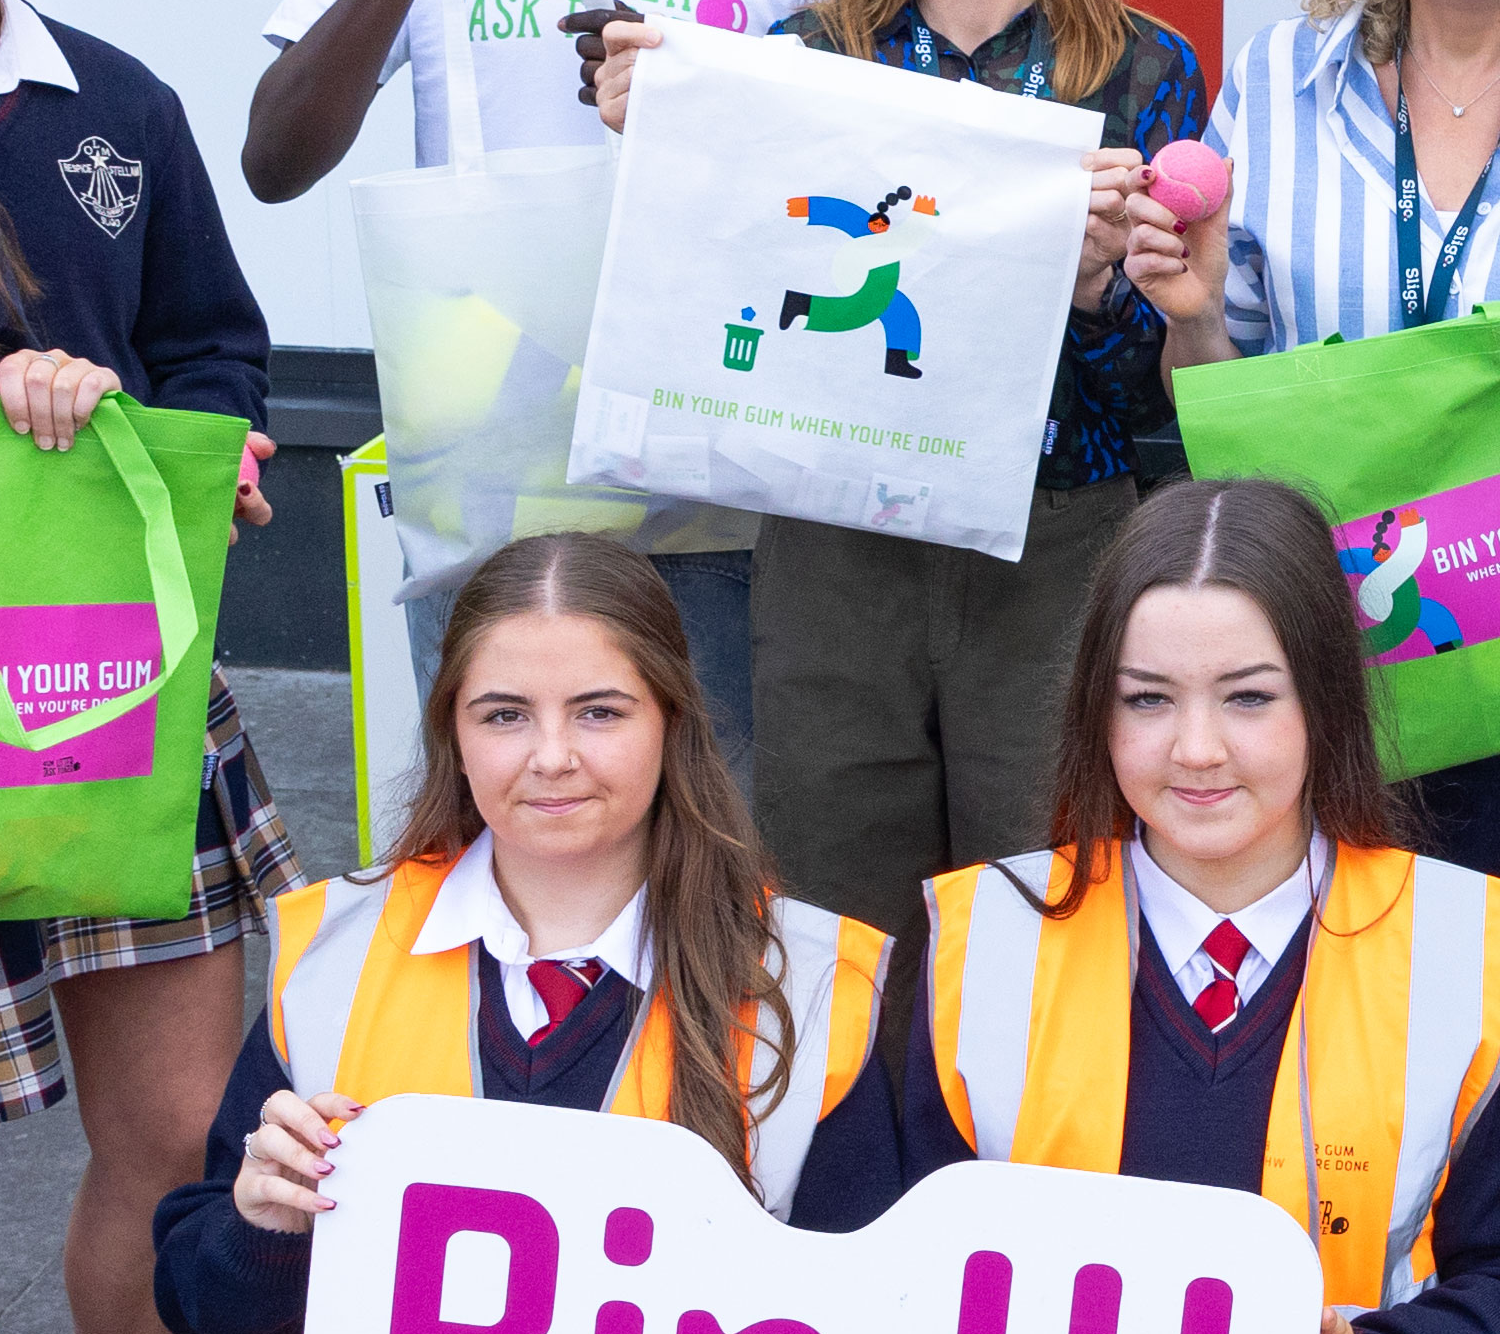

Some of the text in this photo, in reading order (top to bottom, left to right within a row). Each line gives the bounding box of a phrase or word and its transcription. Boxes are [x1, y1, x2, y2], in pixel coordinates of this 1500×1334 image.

[652, 388, 967, 459] BIN YOUR GUM WHEN YOU'RE DONE
[1431, 539, 1477, 575] BIN
[17, 663, 90, 694] YOUR
[99, 660, 152, 690] GUM
[38, 698, 87, 713] YOU'RE
[1325, 1145, 1354, 1156] GUM
[1335, 1160, 1370, 1172] DONE
